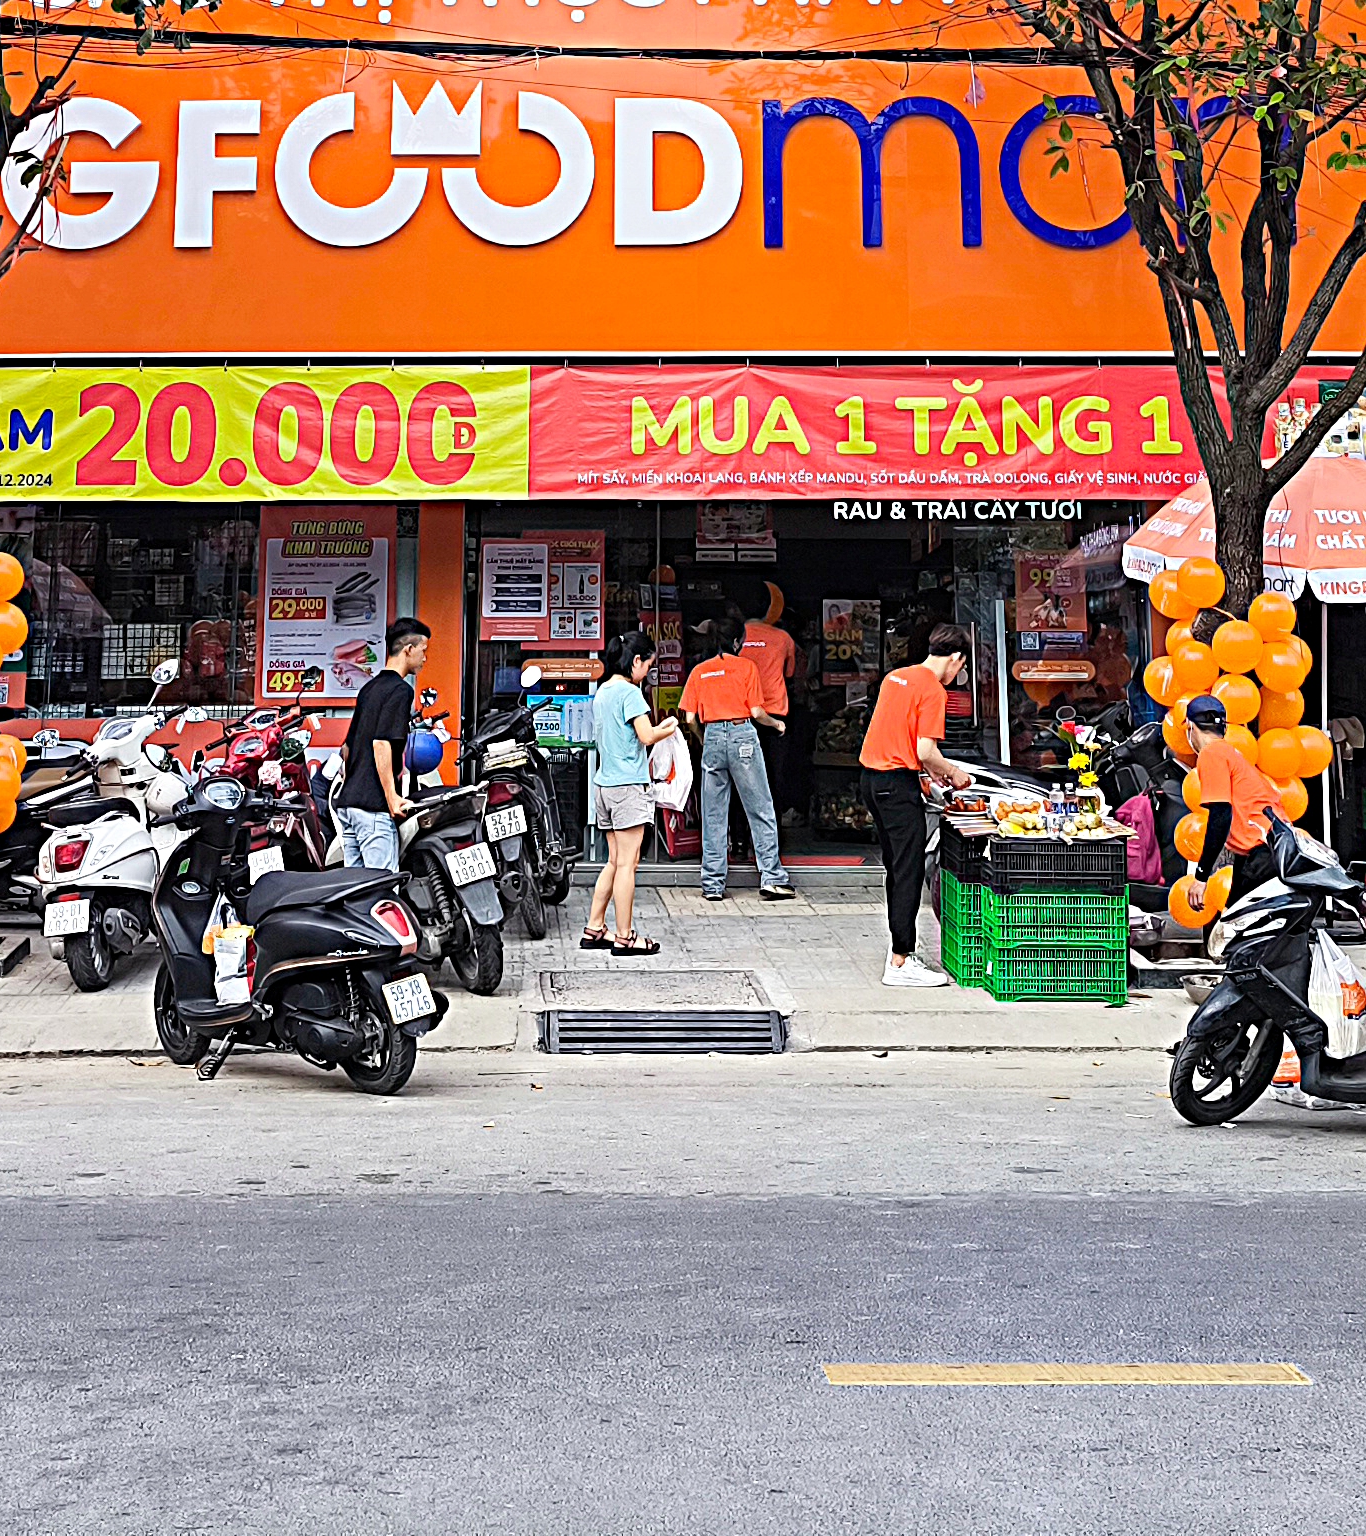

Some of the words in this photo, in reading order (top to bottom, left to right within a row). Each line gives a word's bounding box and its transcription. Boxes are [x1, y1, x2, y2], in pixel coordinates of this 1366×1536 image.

[630, 394, 811, 456] MUA
[834, 395, 878, 456] 1
[894, 377, 1112, 468] TẶNG
[1139, 395, 1184, 456] 1
[577, 470, 599, 485] MÍT
[666, 472, 706, 484] KHOAI
[709, 472, 748, 486] LANG,
[750, 469, 786, 484] BÁNH
[816, 472, 868, 486] MANDU,
[870, 469, 895, 484] SỐT
[966, 470, 993, 485] TRÀ
[995, 473, 1053, 486] OOLONG,
[1107, 474, 1141, 487] SINH,
[1144, 470, 1181, 485] NƯỚC
[833, 501, 882, 520] RAU
[889, 503, 906, 520] &
[912, 498, 967, 520] TRÁI
[974, 498, 1020, 520] CÂY
[1024, 498, 1082, 520] TƯƠI
[285, 540, 317, 555] KHAI
[1316, 530, 1366, 550] CHẤT
[271, 598, 324, 619] 29.000
